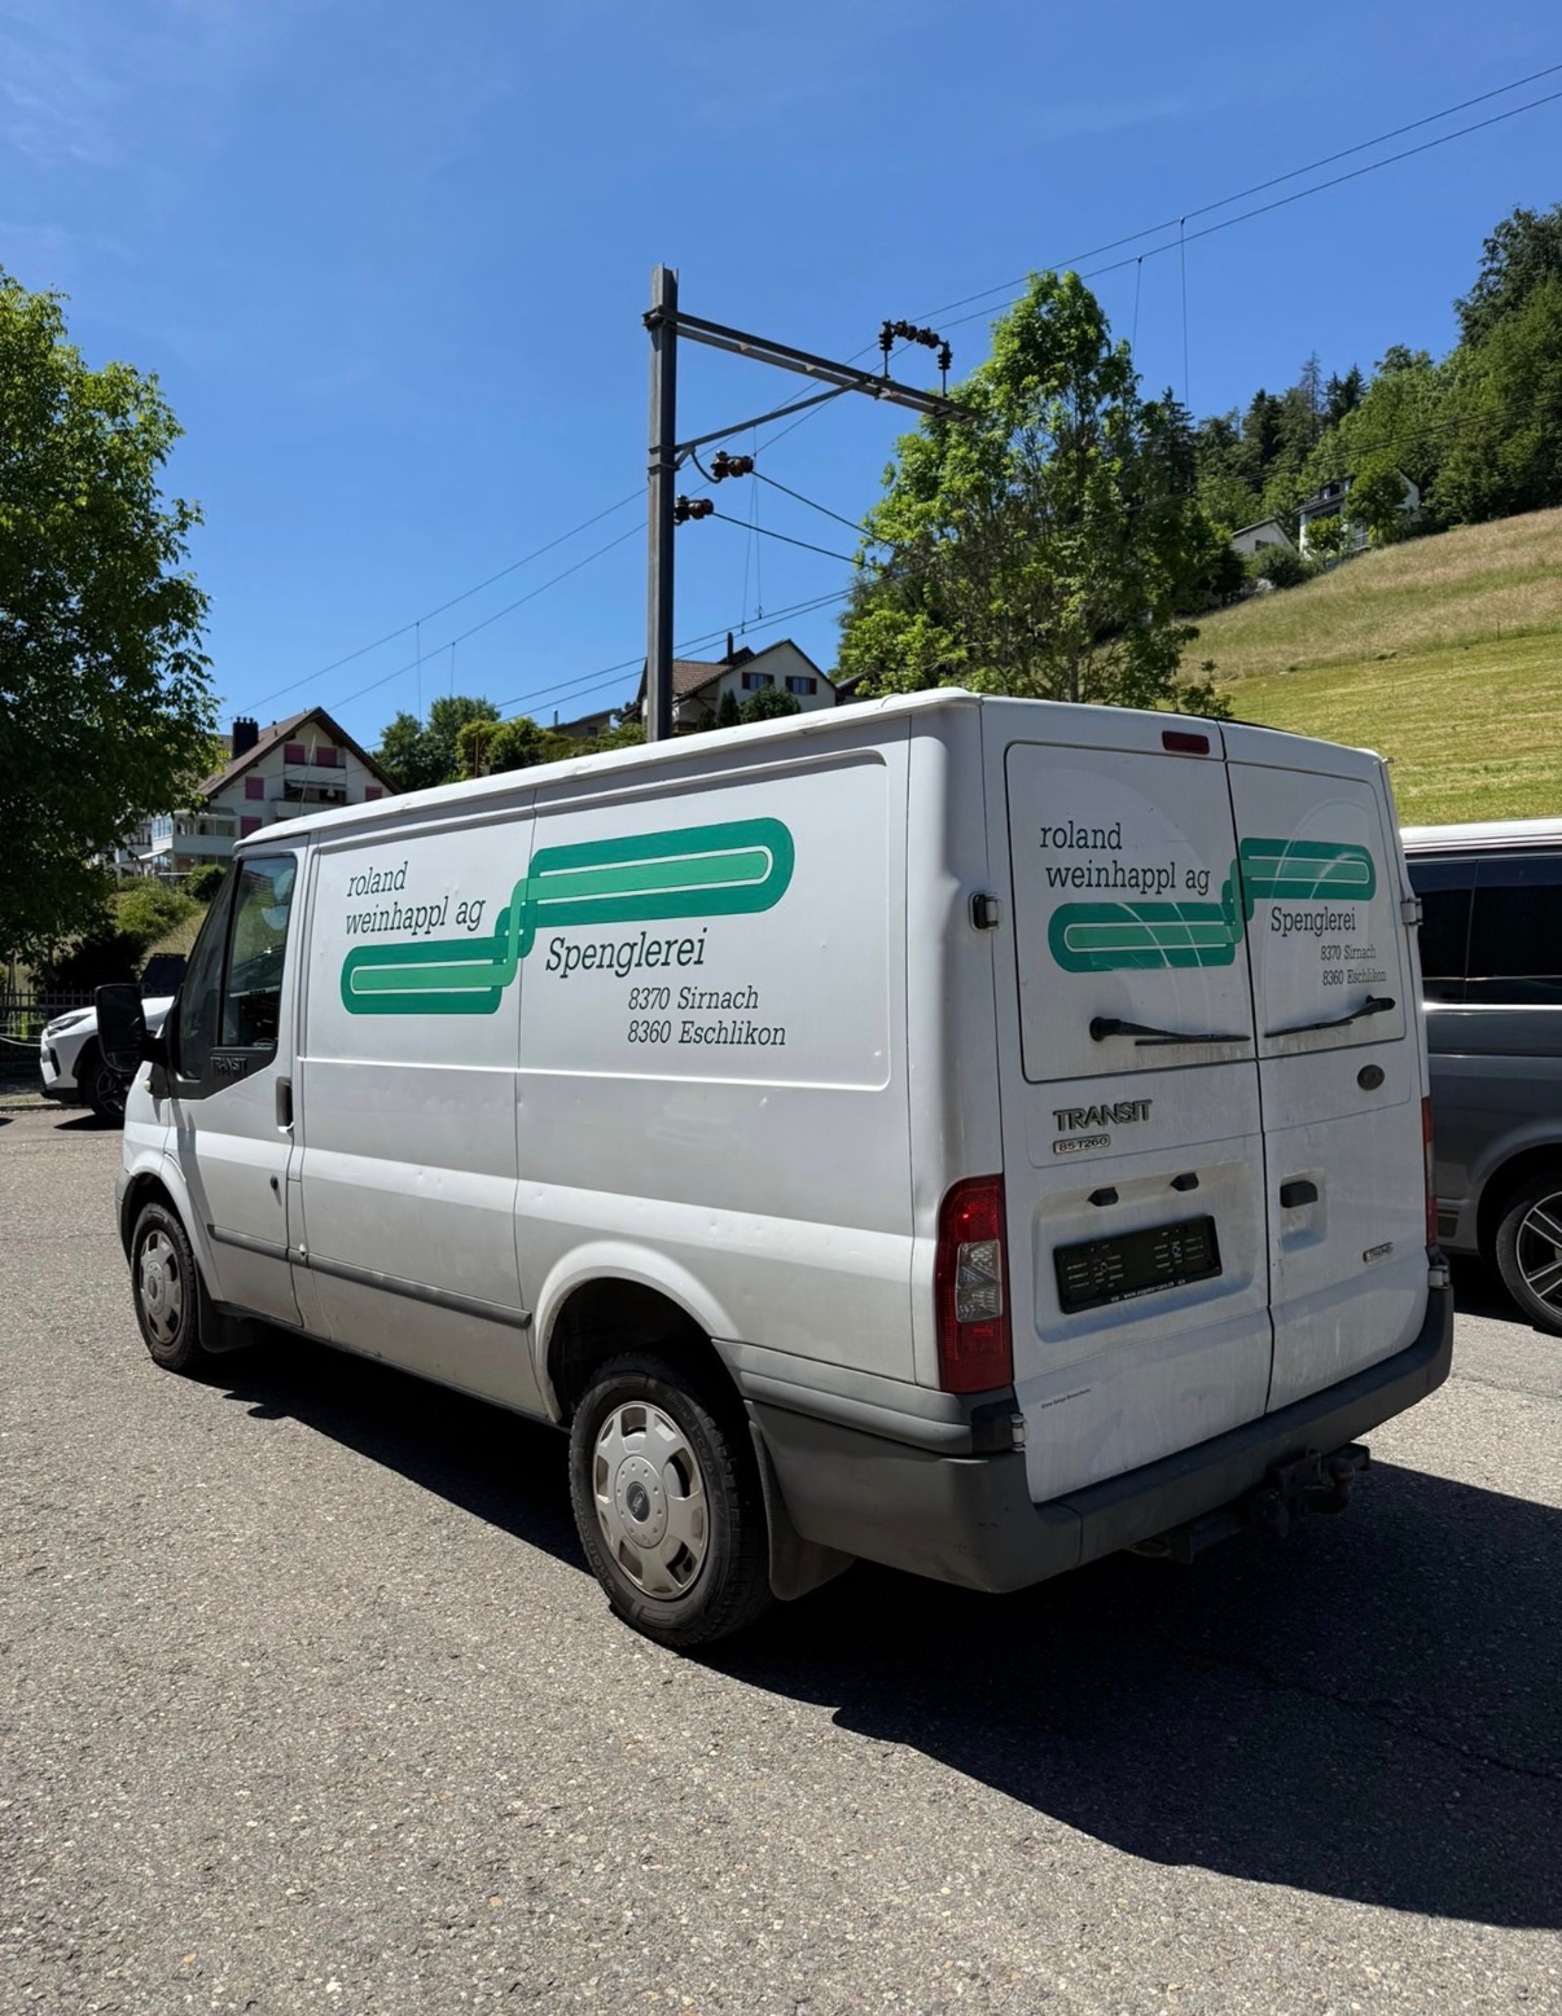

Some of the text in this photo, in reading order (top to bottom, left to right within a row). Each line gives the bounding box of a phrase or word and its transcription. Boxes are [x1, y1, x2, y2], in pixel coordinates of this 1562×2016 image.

[1039, 820, 1123, 850] roland
[346, 860, 409, 898] roland
[1045, 859, 1211, 897] weinhappl ag
[345, 895, 487, 936] weinhappl ag
[1271, 906, 1357, 938] Spenglerei
[545, 927, 709, 979] Spenglerei
[1320, 944, 1377, 961] 8370 Sirnach
[1322, 967, 1388, 987] 8360 Eschlikon
[628, 985, 759, 1011] 8370 Sirnach
[627, 1019, 787, 1046] 8360 Eschlikon
[1052, 1099, 1153, 1132] TRANSIT
[1077, 1137, 1108, 1149] T260
